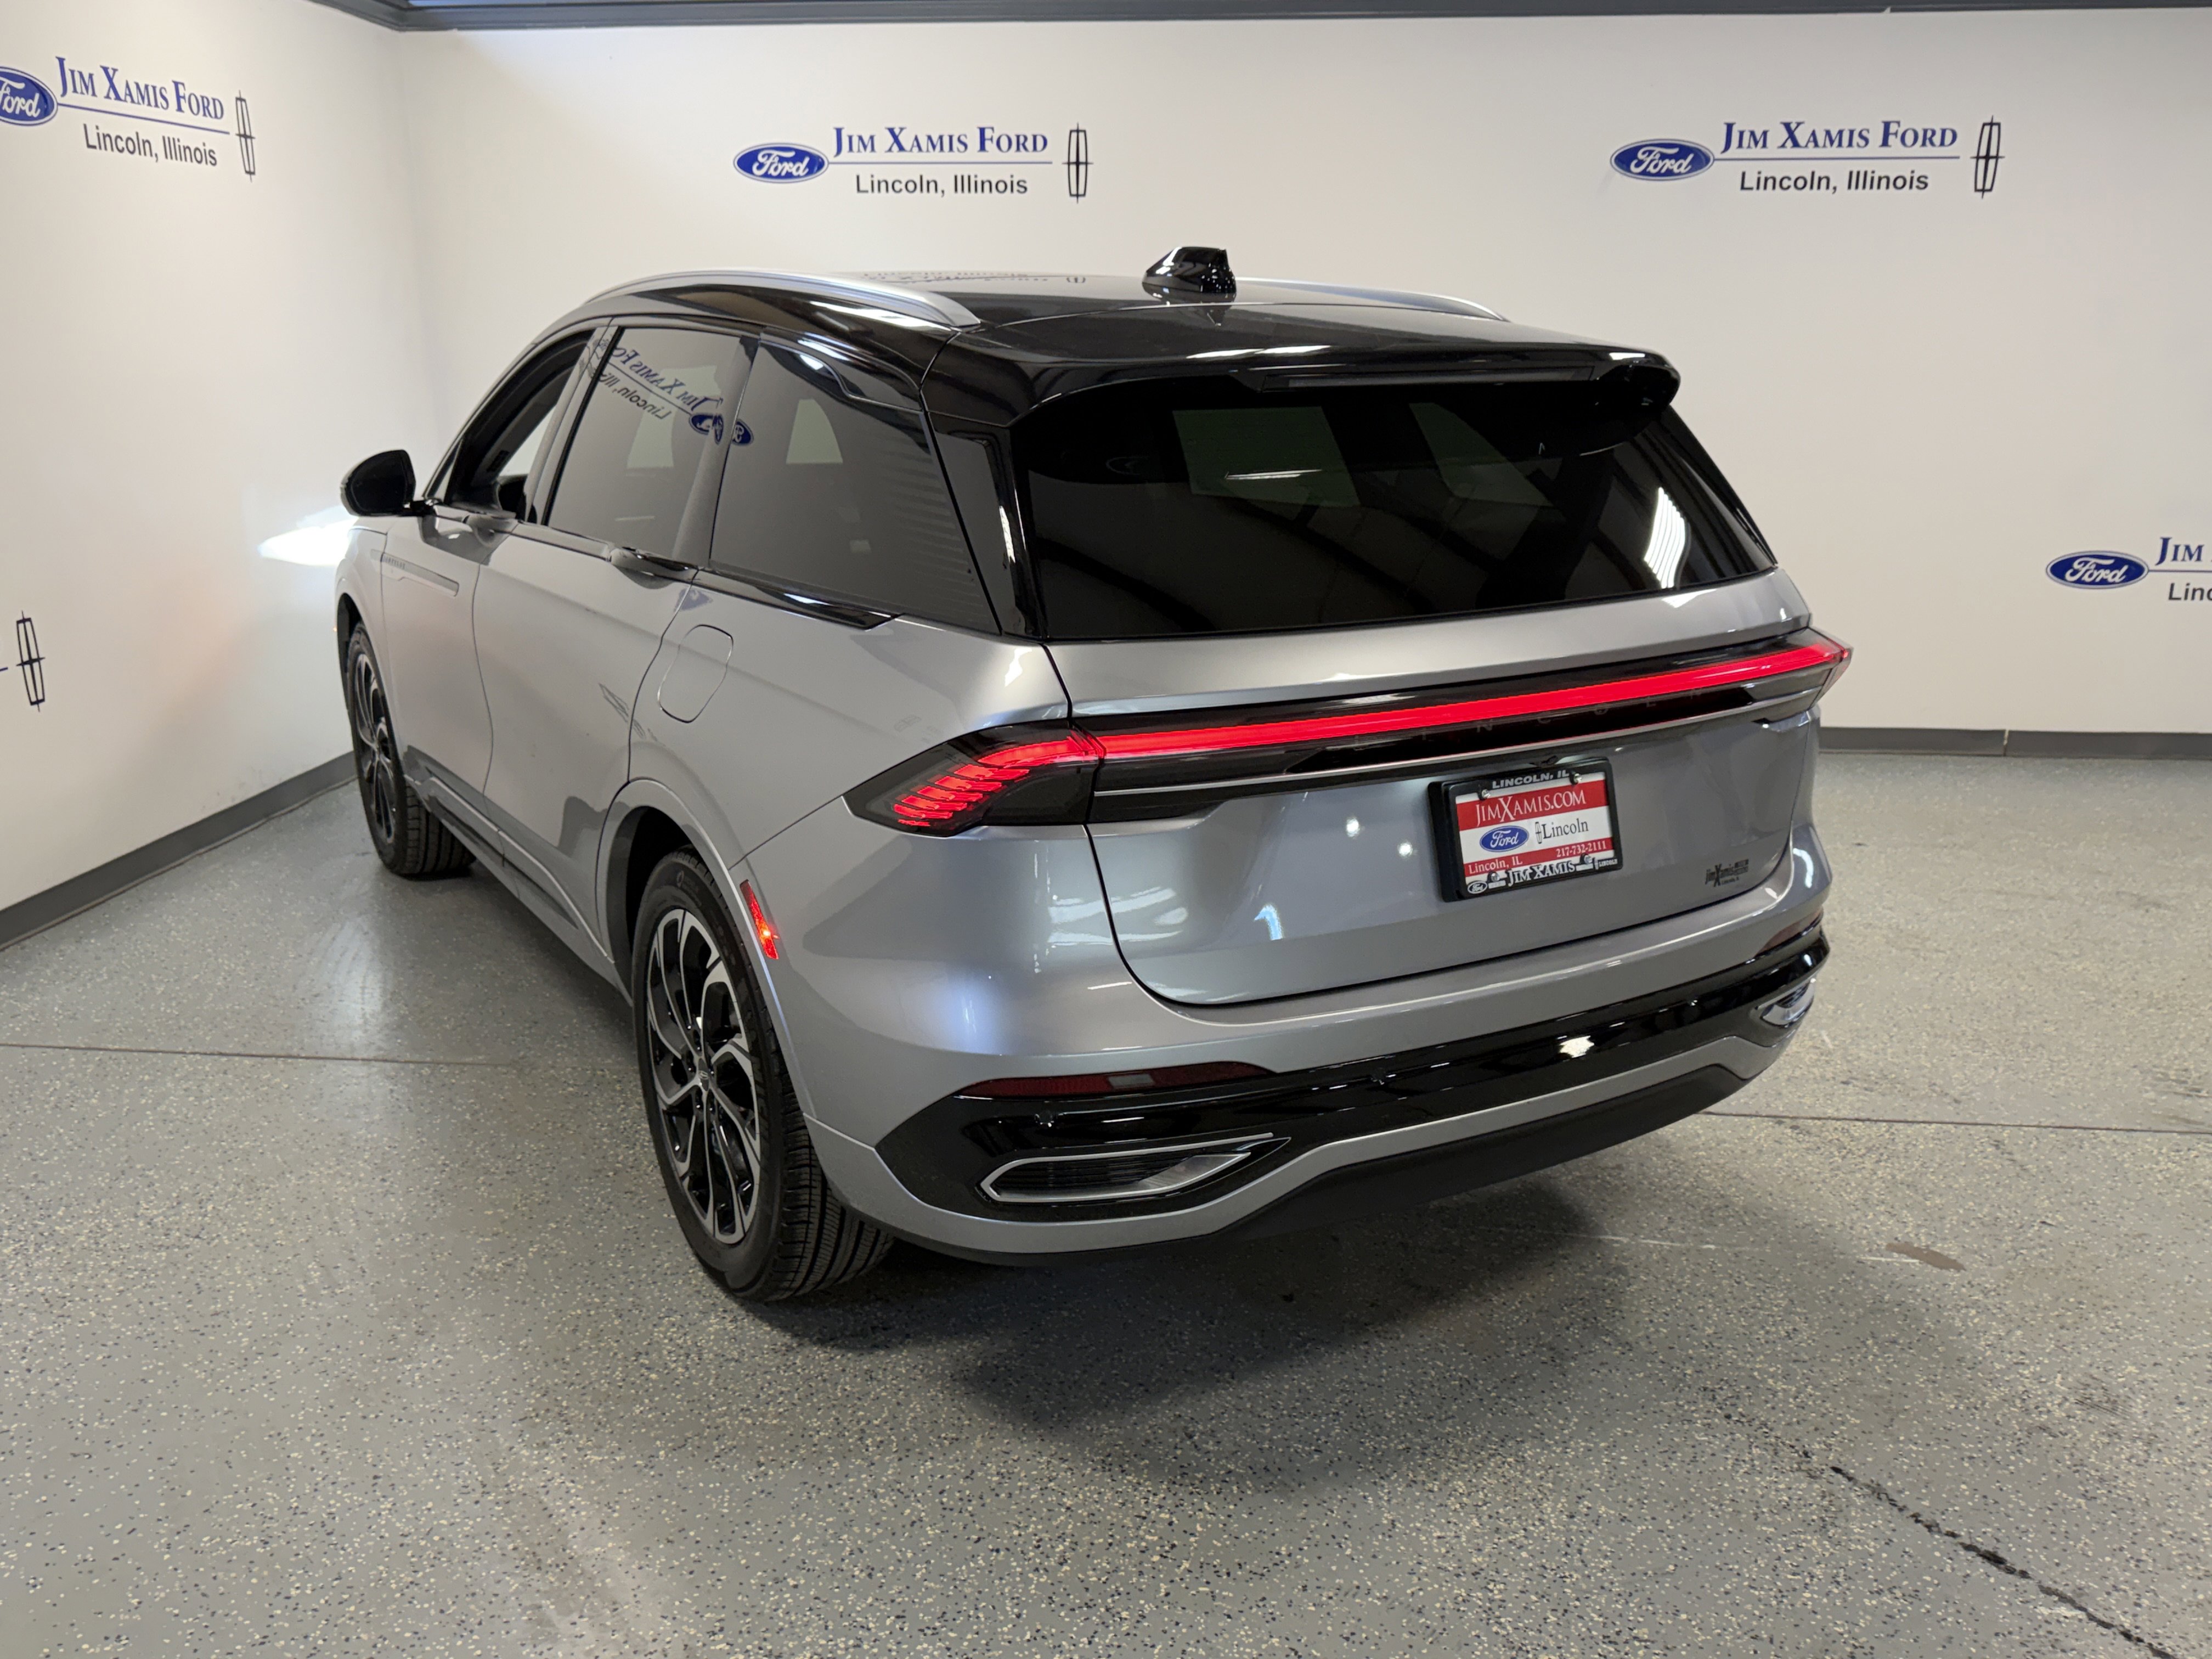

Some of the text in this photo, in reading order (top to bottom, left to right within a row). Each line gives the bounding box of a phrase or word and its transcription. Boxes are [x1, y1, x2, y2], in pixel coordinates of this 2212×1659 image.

[55, 56, 224, 120] JIM XAMIS FORD
[83, 123, 217, 166] Lincoln, Illinois
[833, 127, 1048, 157] JIM XAMIS FORD
[1720, 120, 1957, 154] JIM XAMIS FORD
[856, 174, 1028, 197] Lincoln, Illinois
[1740, 170, 1928, 194] Lincoln, Illinois
[2155, 537, 2204, 566] JIM
[1492, 770, 1570, 789] LINCOLN, IL
[1541, 818, 1589, 839] Lincoln
[1556, 840, 1607, 857] 217-732-2111
[1469, 856, 1523, 874] Lincoln, IL
[1507, 860, 1576, 887] JIM XAMIS
